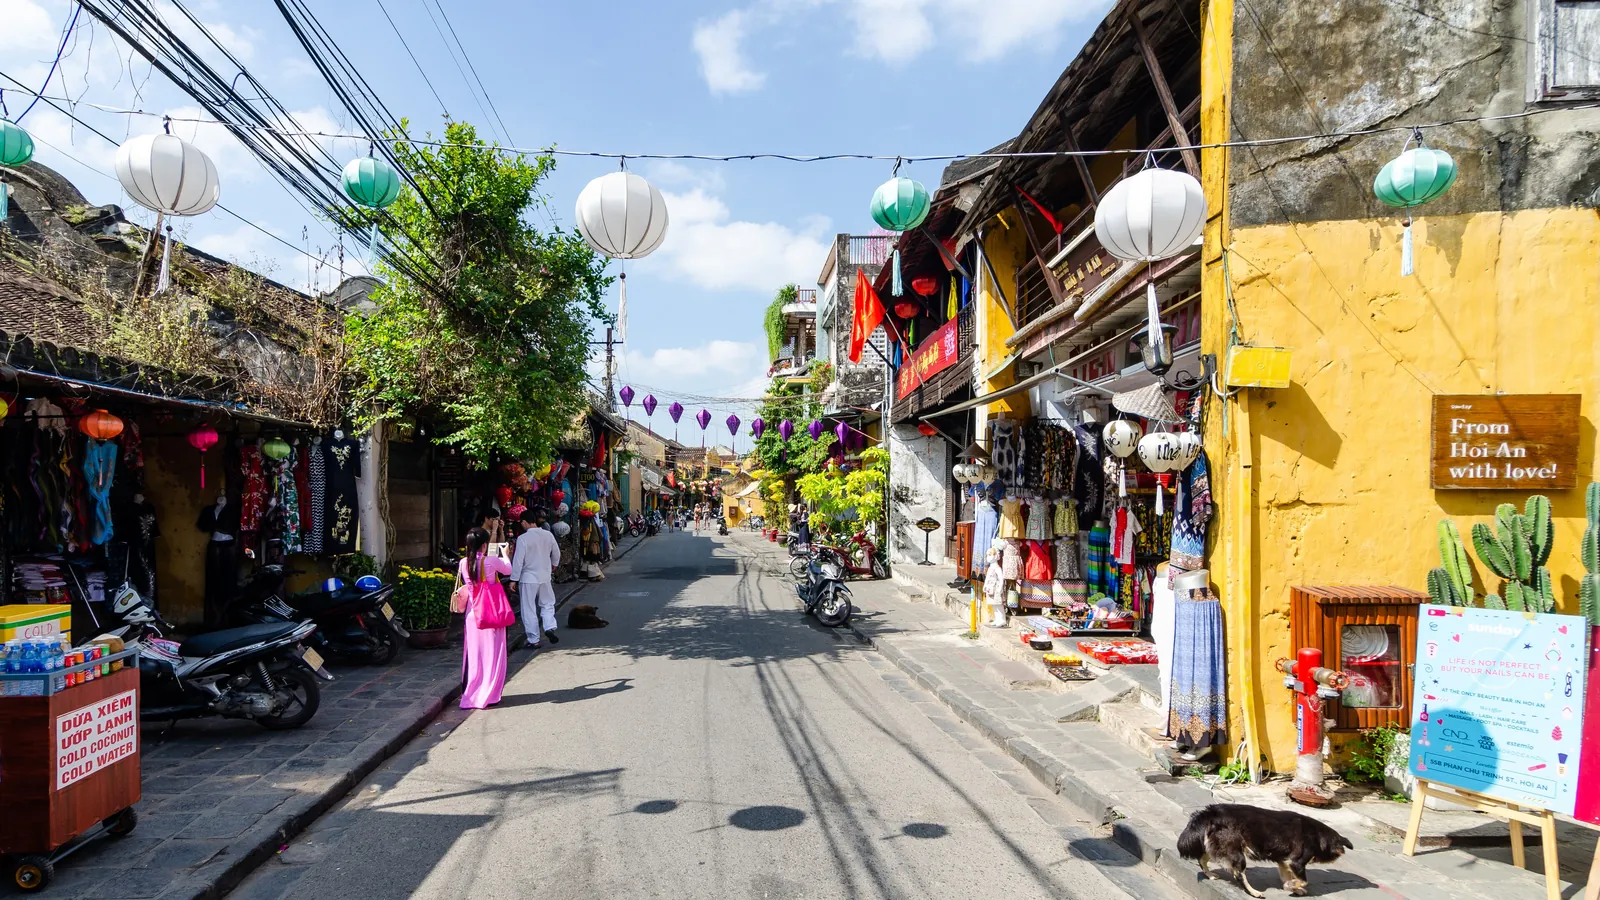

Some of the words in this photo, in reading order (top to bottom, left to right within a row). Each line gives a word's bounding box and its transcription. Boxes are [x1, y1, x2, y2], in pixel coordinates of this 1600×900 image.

[1450, 418, 1509, 435] From
[1450, 441, 1489, 458] Hoi
[1495, 441, 1526, 458] An
[1449, 462, 1497, 479] with
[1504, 463, 1557, 479] love!
[24, 623, 53, 639] COLD
[1467, 622, 1522, 638] sunday
[1448, 657, 1466, 666] LIFE
[1478, 659, 1497, 667] NOT
[1500, 661, 1541, 670] PERFECT
[1440, 665, 1458, 673] BUT
[1459, 666, 1482, 675] YOUR
[1485, 668, 1512, 677] NAILS
[1514, 671, 1535, 679] CAN
[1538, 672, 1550, 680] BE
[1477, 692, 1500, 701] BEAUTY
[61, 711, 93, 733] DỪA
[97, 695, 132, 719] XIÊM
[61, 727, 92, 750] ƯỚP
[97, 710, 132, 735] LẠNH
[1448, 713, 1473, 722] MASSAGE
[1507, 724, 1539, 734] COCKTAILS
[1442, 728, 1468, 740] CND
[60, 746, 87, 768] COLD
[90, 725, 134, 754] COCONUT
[61, 760, 93, 784] COLD
[97, 741, 133, 767] WATER
[1443, 761, 1462, 771] PHAN
[1463, 767, 1480, 775] CHU
[1481, 770, 1504, 780] TRINH
[1536, 783, 1548, 791] AN
